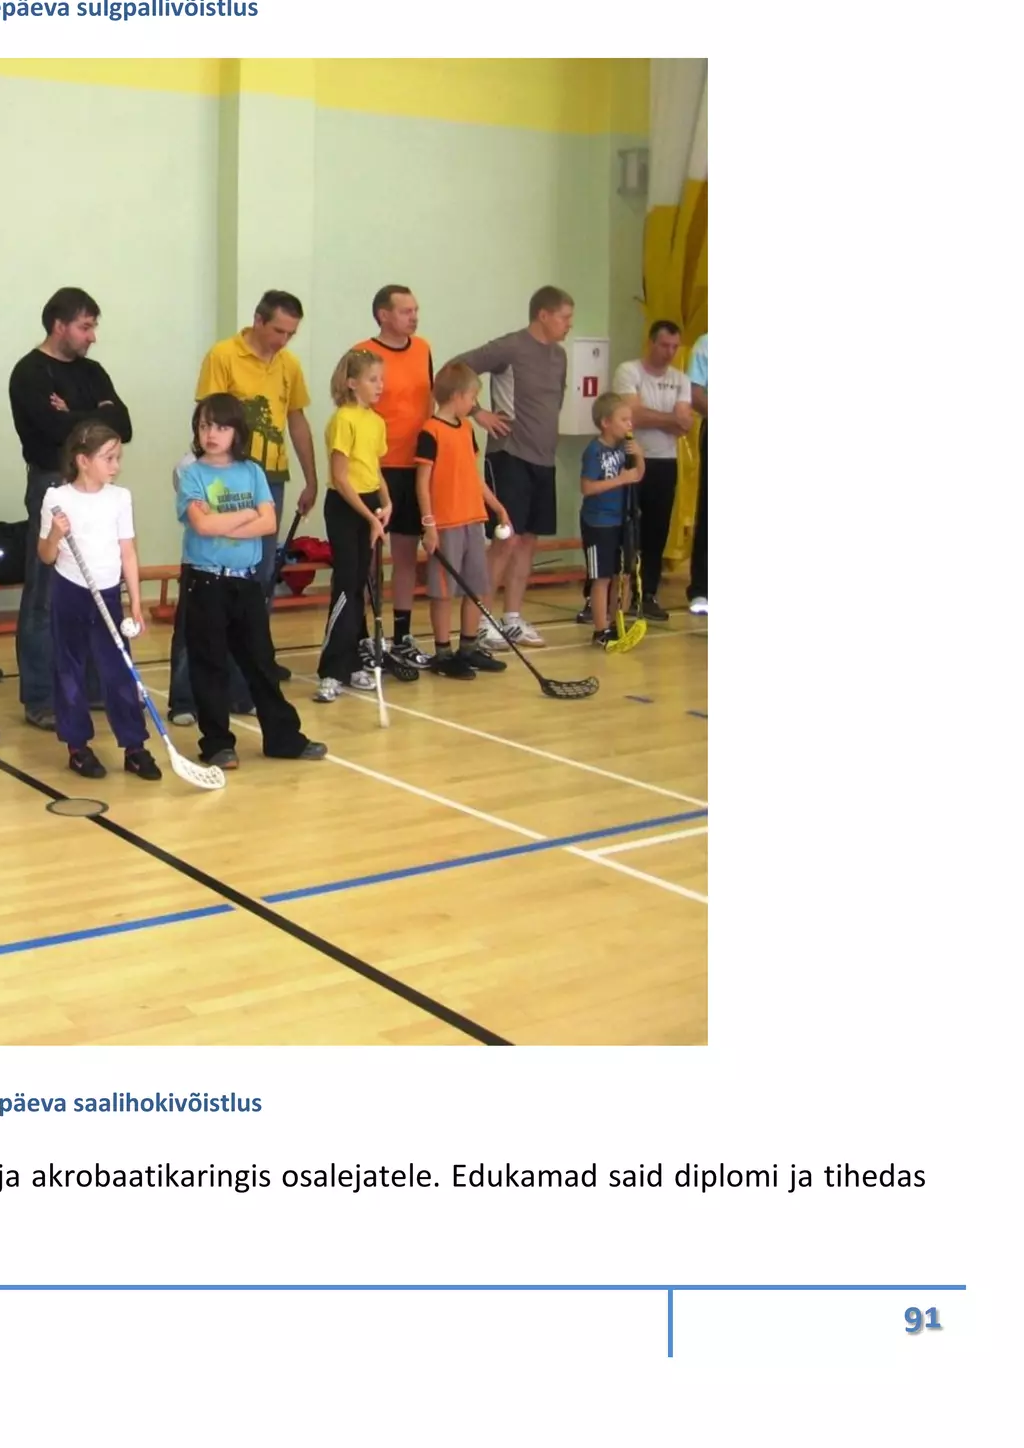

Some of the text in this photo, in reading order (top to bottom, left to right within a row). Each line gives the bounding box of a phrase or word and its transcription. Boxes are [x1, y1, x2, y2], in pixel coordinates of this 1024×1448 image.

[73, 1091, 263, 1113] saalihokivõistlus
[31, 1162, 271, 1194] akrobaatikaringis
[281, 1162, 440, 1194] osalejatele.
[452, 1162, 597, 1188] Edukamad
[608, 1162, 663, 1188] said
[674, 1162, 778, 1194] diplomi
[787, 1163, 813, 1194] ja
[823, 1162, 926, 1188] tihedas
[903, 1306, 943, 1336] 91
